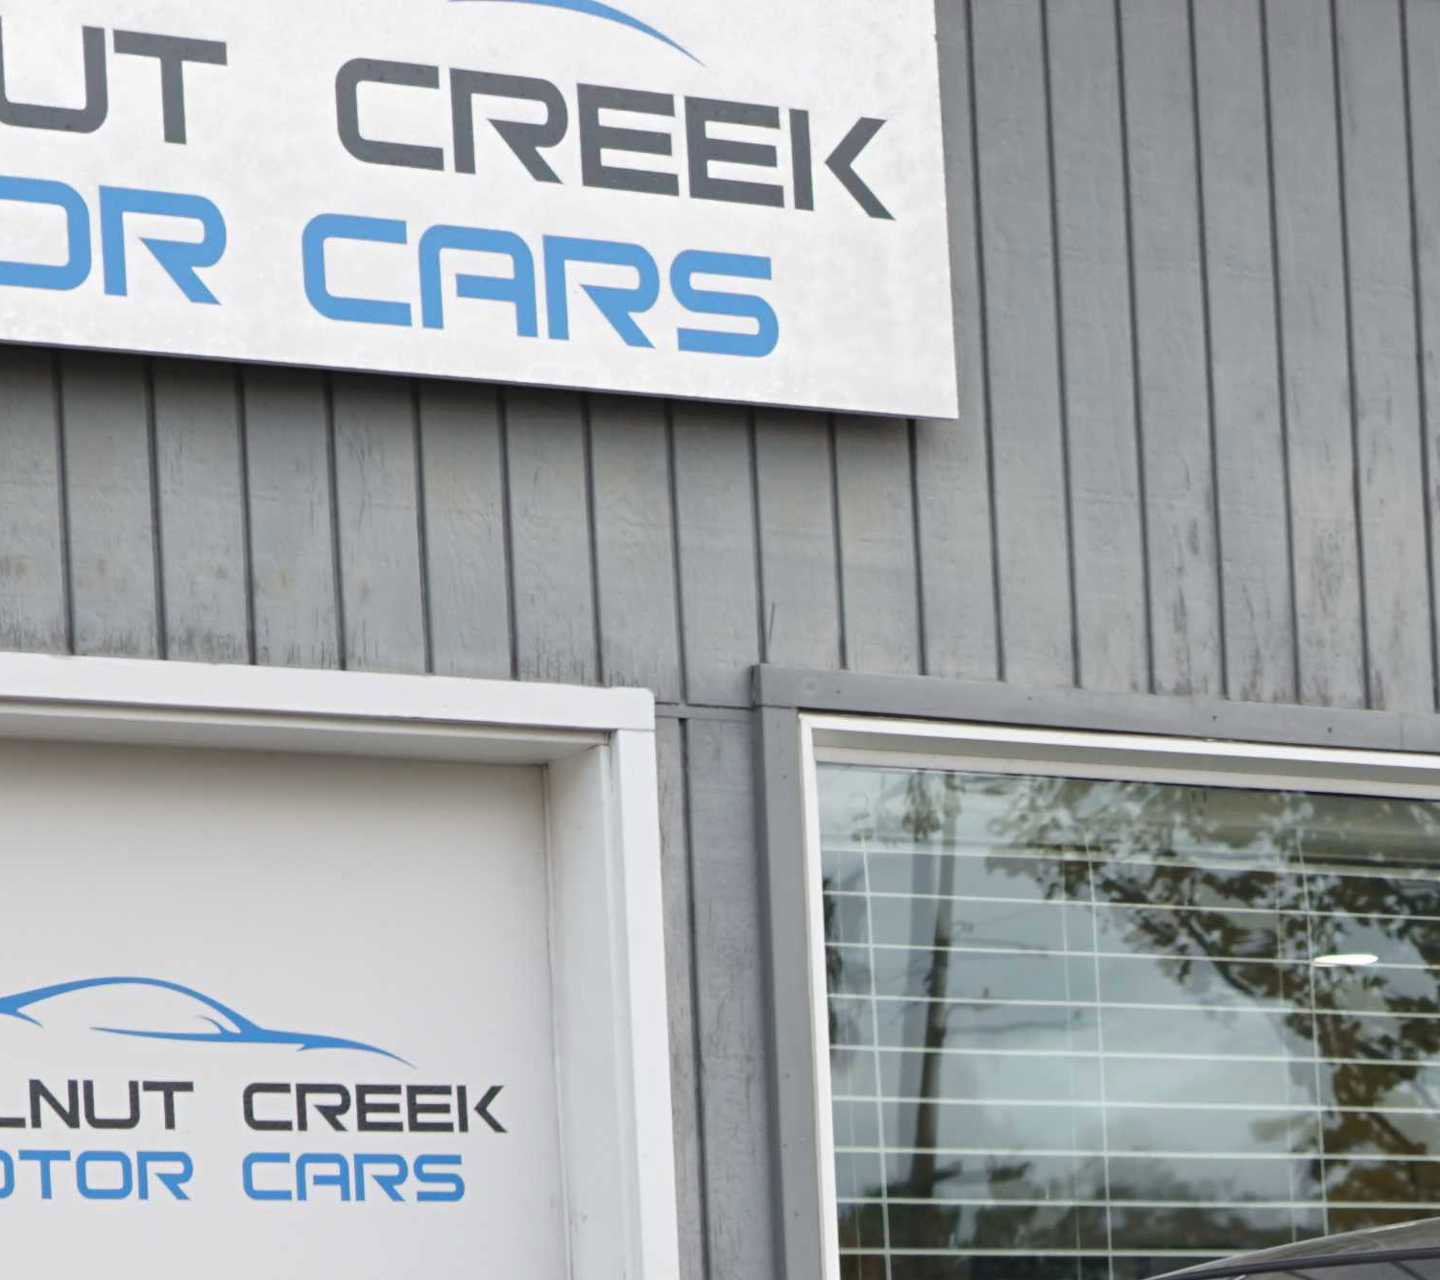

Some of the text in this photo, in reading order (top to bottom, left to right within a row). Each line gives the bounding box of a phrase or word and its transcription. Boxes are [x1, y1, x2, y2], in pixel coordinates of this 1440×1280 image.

[334, 57, 897, 222] CREEK
[302, 213, 780, 358] CARS
[242, 1082, 507, 1134] CREEK
[242, 1151, 465, 1203] CARS
